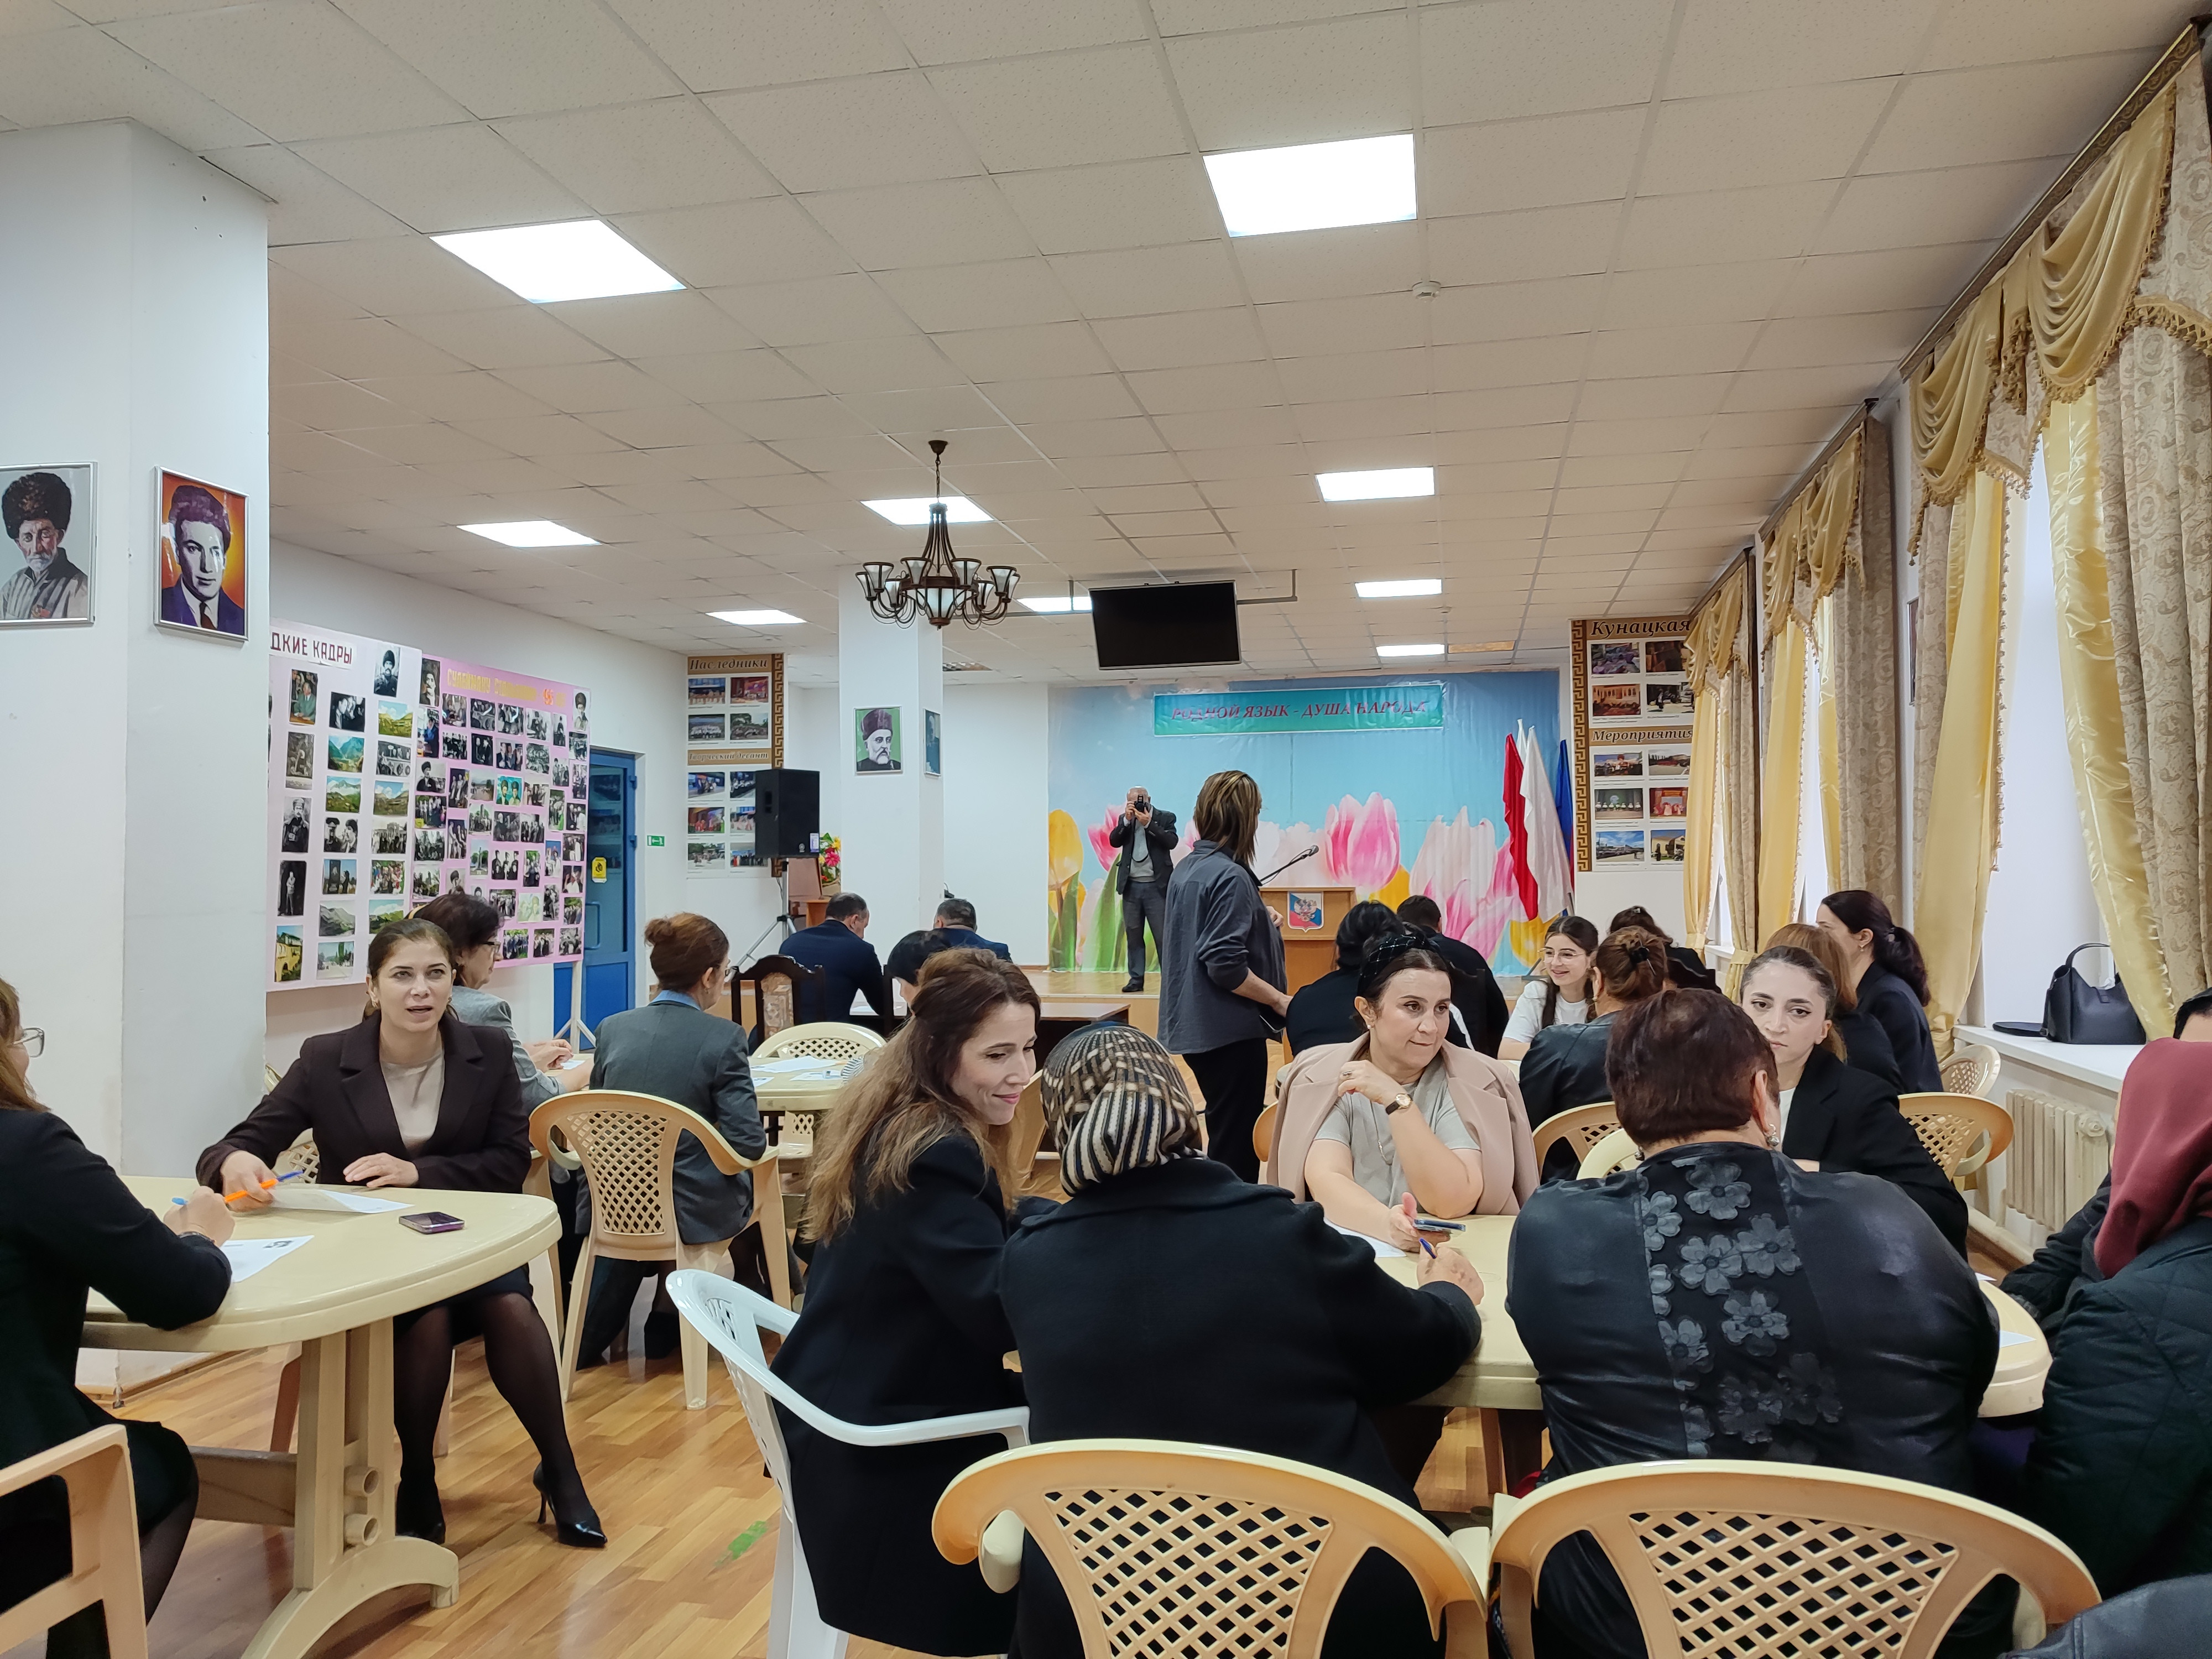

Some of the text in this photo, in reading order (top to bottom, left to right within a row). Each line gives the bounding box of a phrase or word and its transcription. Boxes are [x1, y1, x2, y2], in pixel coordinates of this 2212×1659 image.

[1591, 620, 1690, 639] Кунацкая
[313, 640, 352, 664] КАДРЫ
[690, 658, 767, 670] Наследники
[1171, 704, 1240, 722] РОДНОЙ
[1243, 705, 1290, 718] ЯЗЫК
[1301, 703, 1350, 719] ДУША
[1357, 701, 1427, 715] НАРОДА
[1593, 729, 1693, 743] Мероприятия
[736, 751, 768, 760] десант
